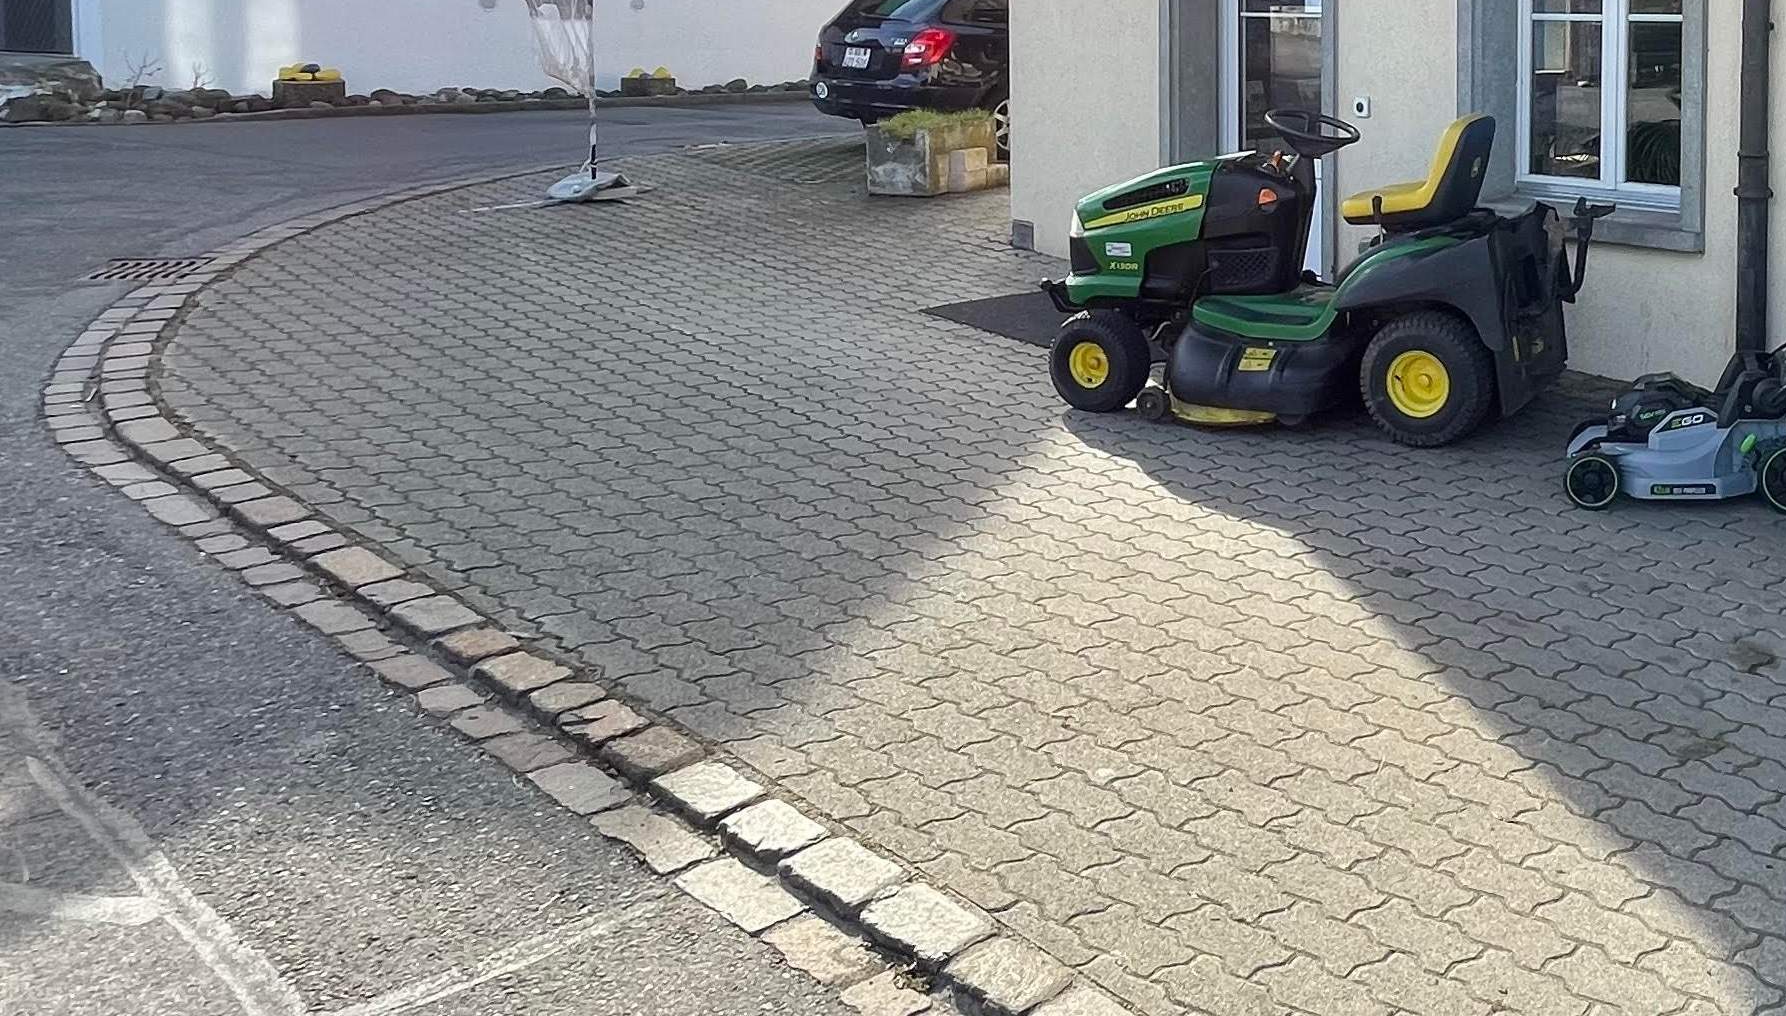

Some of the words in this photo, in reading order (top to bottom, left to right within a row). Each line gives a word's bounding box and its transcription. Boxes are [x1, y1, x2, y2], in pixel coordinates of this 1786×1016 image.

[1123, 209, 1150, 222] JOHN
[1151, 203, 1184, 216] DEERE
[1671, 414, 1704, 428] EGO
